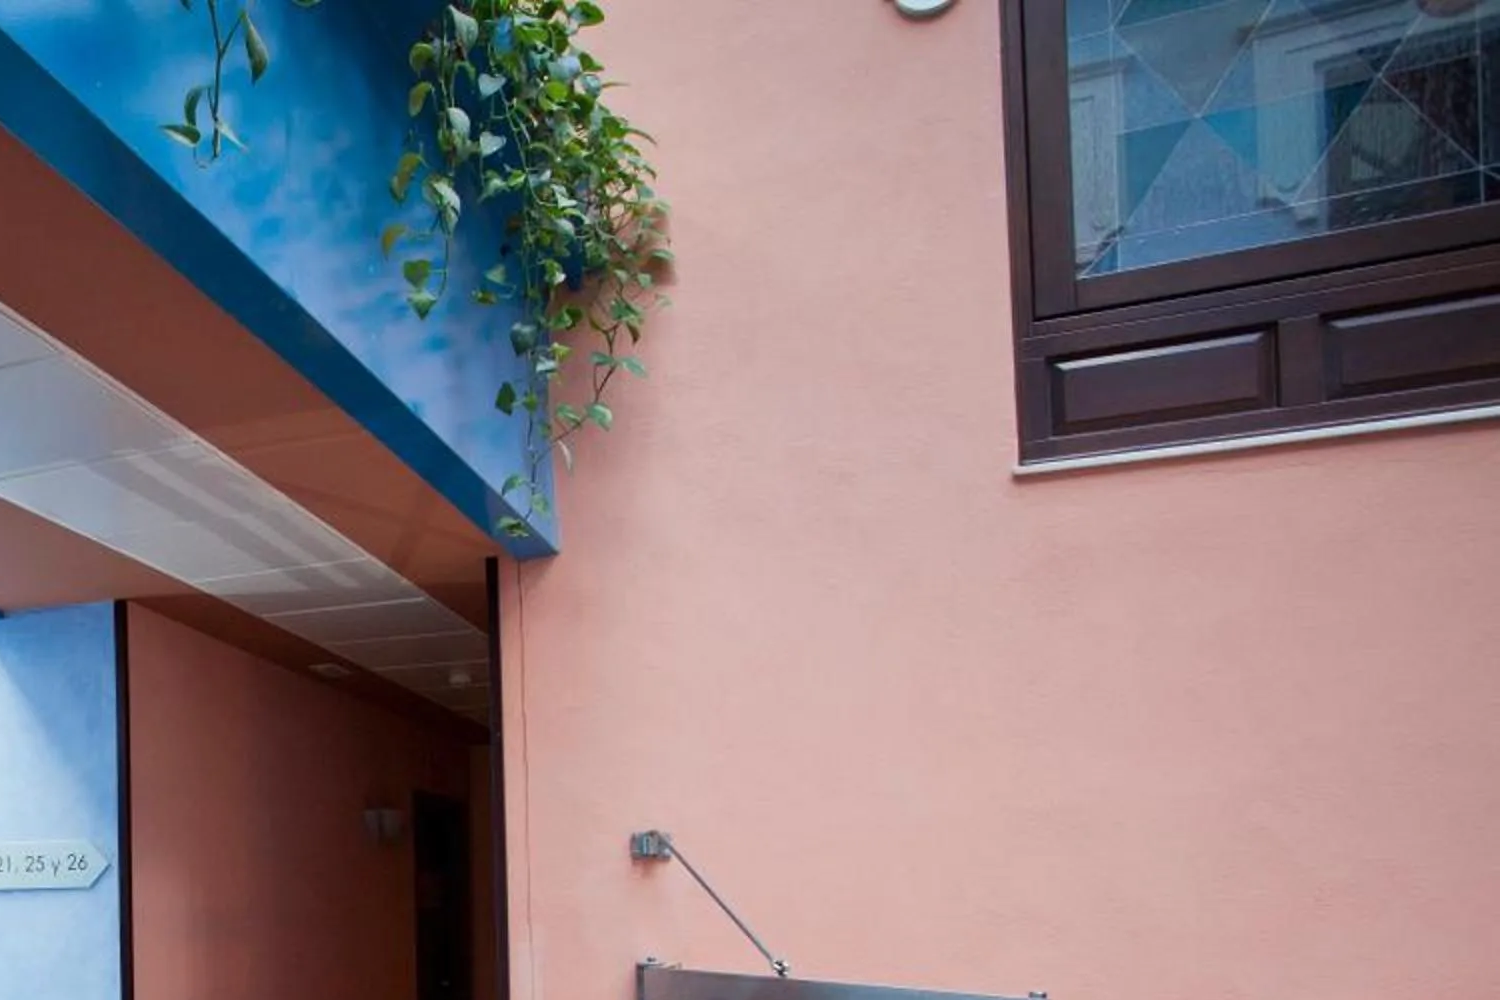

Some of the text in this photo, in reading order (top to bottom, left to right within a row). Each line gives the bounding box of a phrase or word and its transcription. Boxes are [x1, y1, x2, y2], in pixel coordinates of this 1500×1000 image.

[25, 855, 45, 873] 25
[51, 859, 61, 877] y
[67, 854, 88, 871] 26
